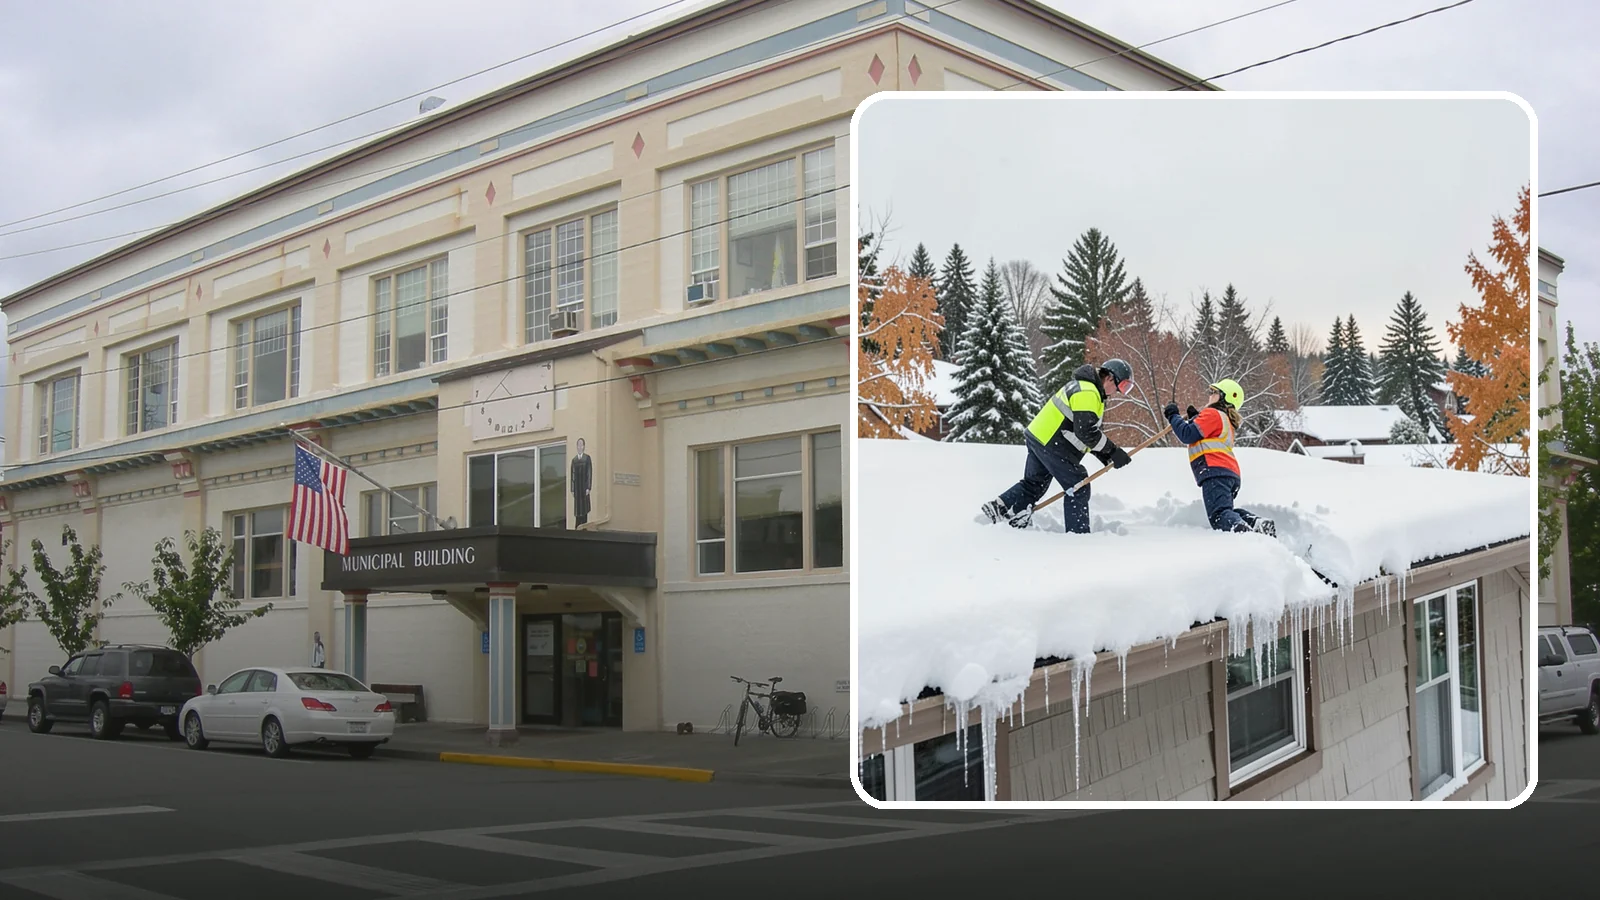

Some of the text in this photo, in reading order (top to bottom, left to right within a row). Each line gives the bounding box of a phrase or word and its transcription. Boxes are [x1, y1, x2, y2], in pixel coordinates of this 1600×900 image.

[546, 361, 551, 370] 6
[536, 402, 540, 410] 4
[488, 417, 492, 426] 9
[529, 414, 533, 422] 3
[494, 423, 500, 432] 10
[521, 420, 525, 428] 2
[507, 425, 513, 433] 12
[342, 546, 475, 572] MUNICIPAL BUILDING
